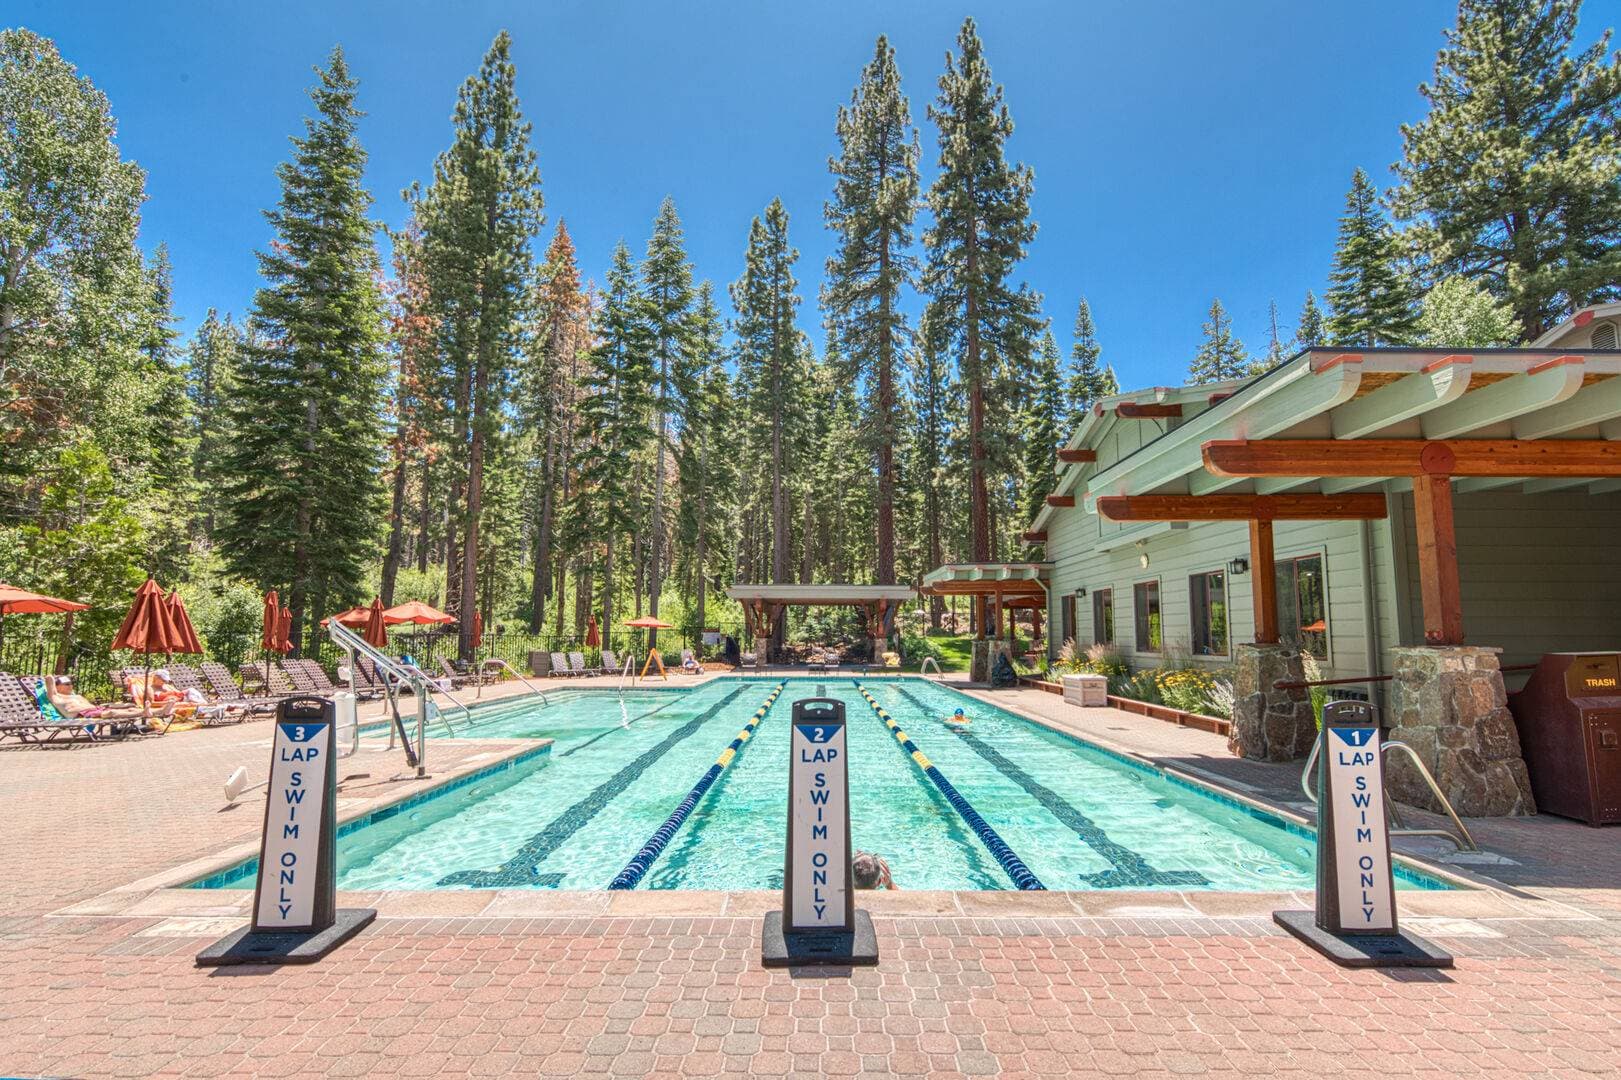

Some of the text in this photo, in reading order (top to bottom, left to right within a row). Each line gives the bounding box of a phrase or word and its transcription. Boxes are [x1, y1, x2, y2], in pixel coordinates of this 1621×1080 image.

[1585, 678, 1616, 687] TRASH
[294, 726, 305, 741] 3
[813, 727, 824, 742] 2
[1351, 730, 1361, 745] 1
[281, 747, 319, 762] LAP
[801, 748, 838, 763] LAP
[1339, 751, 1374, 766] LAP
[278, 771, 306, 920] SWIM ONLY
[810, 772, 830, 920] SWIM ONLY
[1351, 776, 1374, 922] SWIM ONLY
